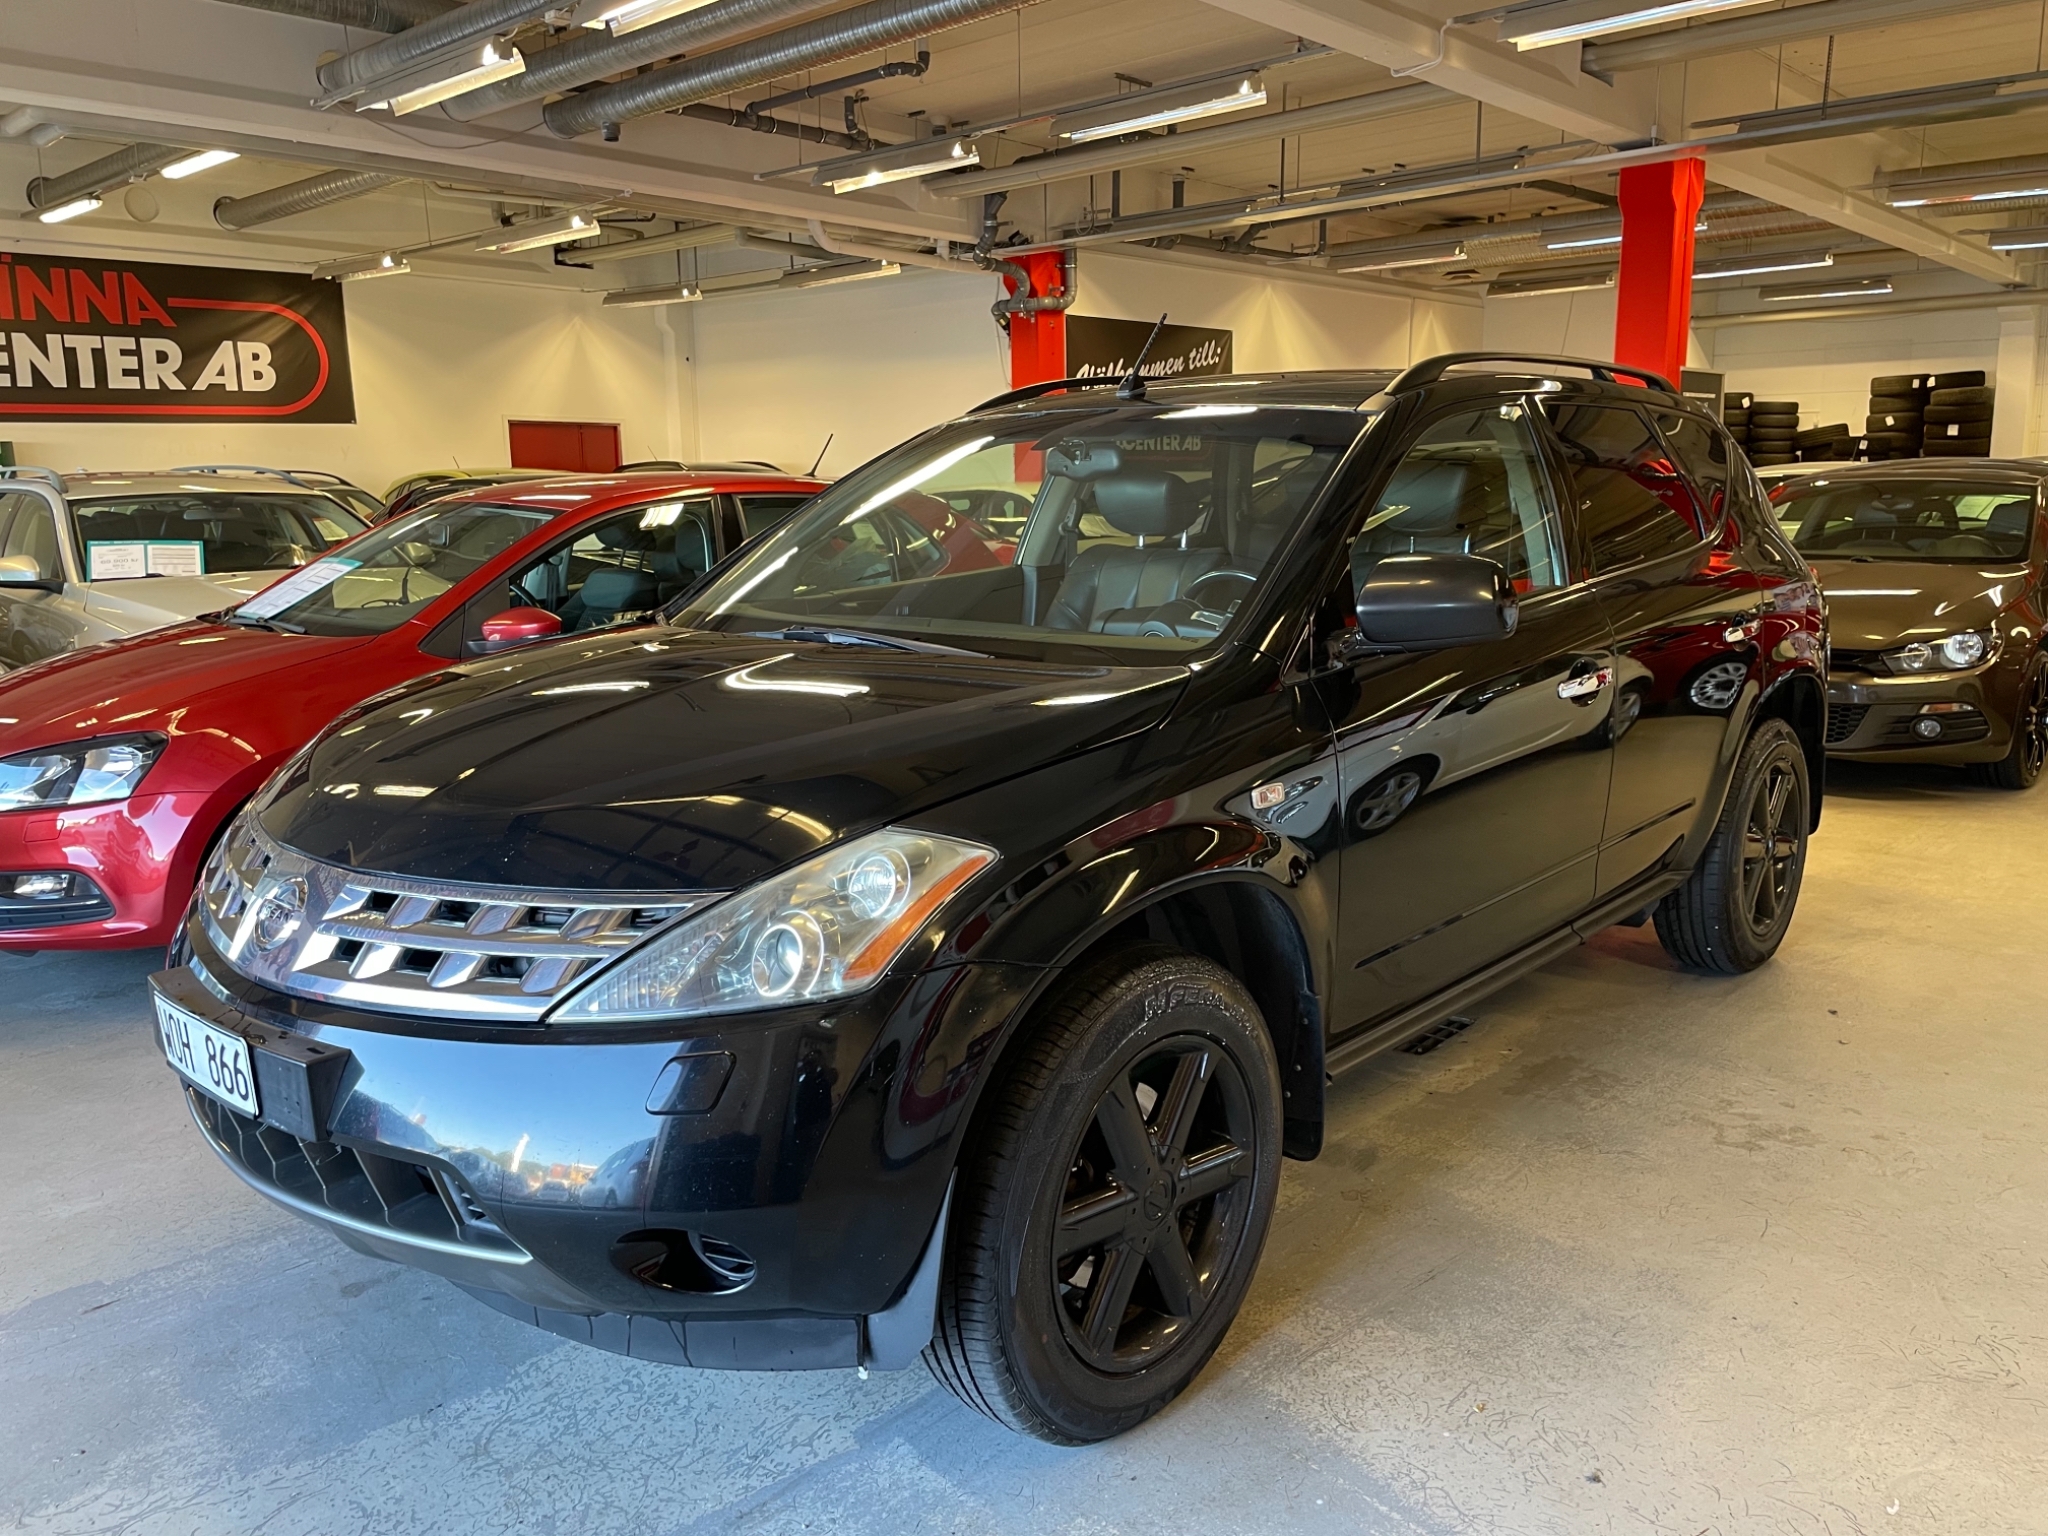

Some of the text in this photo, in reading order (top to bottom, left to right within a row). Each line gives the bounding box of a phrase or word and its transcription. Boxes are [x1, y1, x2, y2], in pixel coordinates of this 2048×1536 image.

[192, 340, 277, 392] AB
[1189, 340, 1221, 370] till:
[205, 1034, 249, 1102] 866
